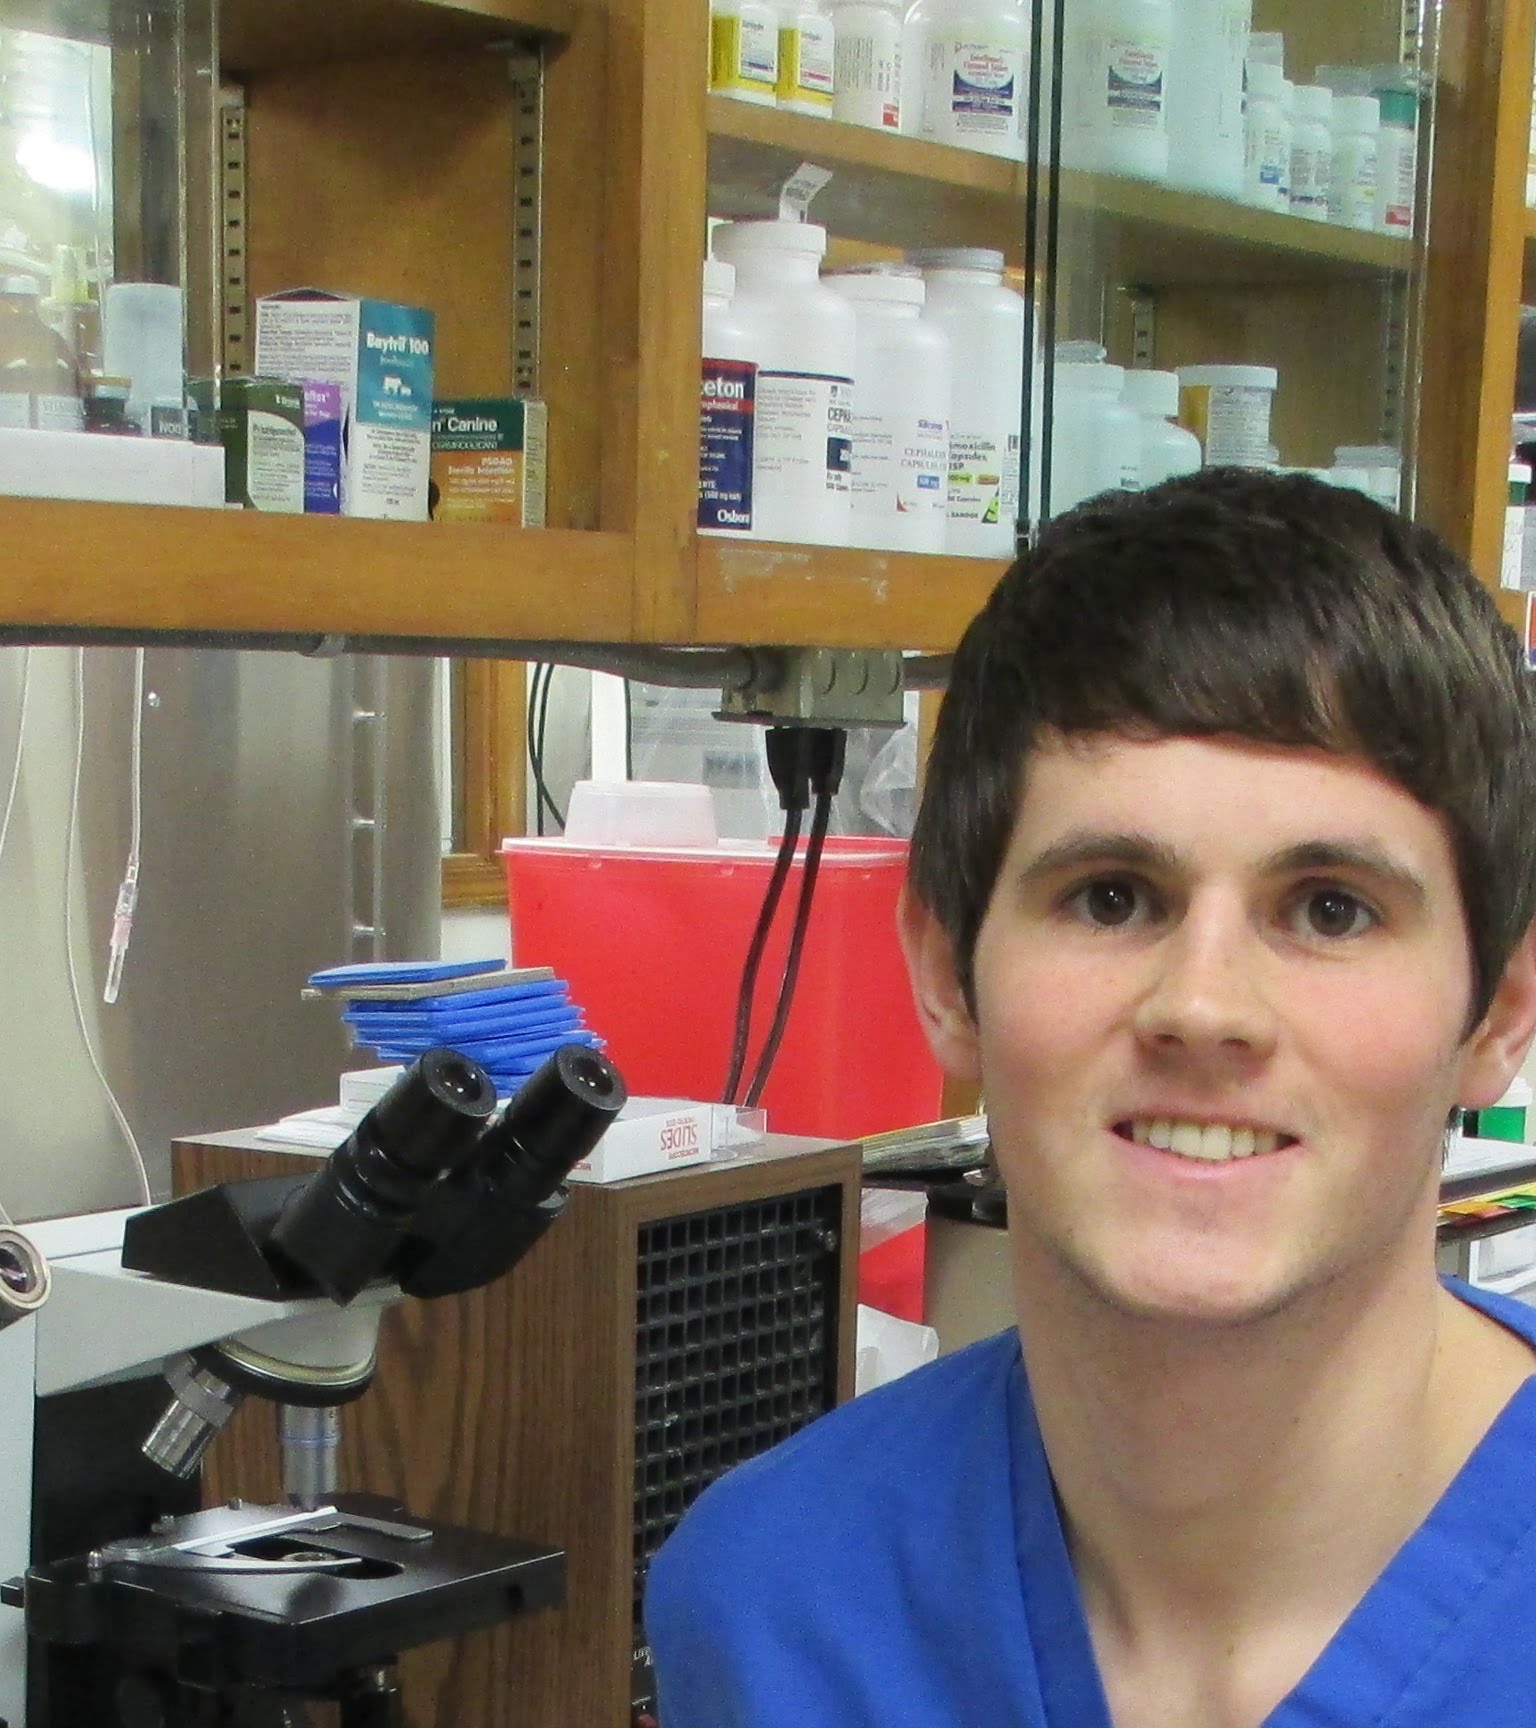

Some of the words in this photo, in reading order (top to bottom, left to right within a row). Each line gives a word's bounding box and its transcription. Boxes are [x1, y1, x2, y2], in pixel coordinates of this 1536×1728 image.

[366, 331, 406, 354] Baytril
[409, 335, 430, 355] 100
[701, 376, 745, 399] eton
[447, 416, 499, 433] Canine
[660, 1123, 699, 1151] SLIDES
